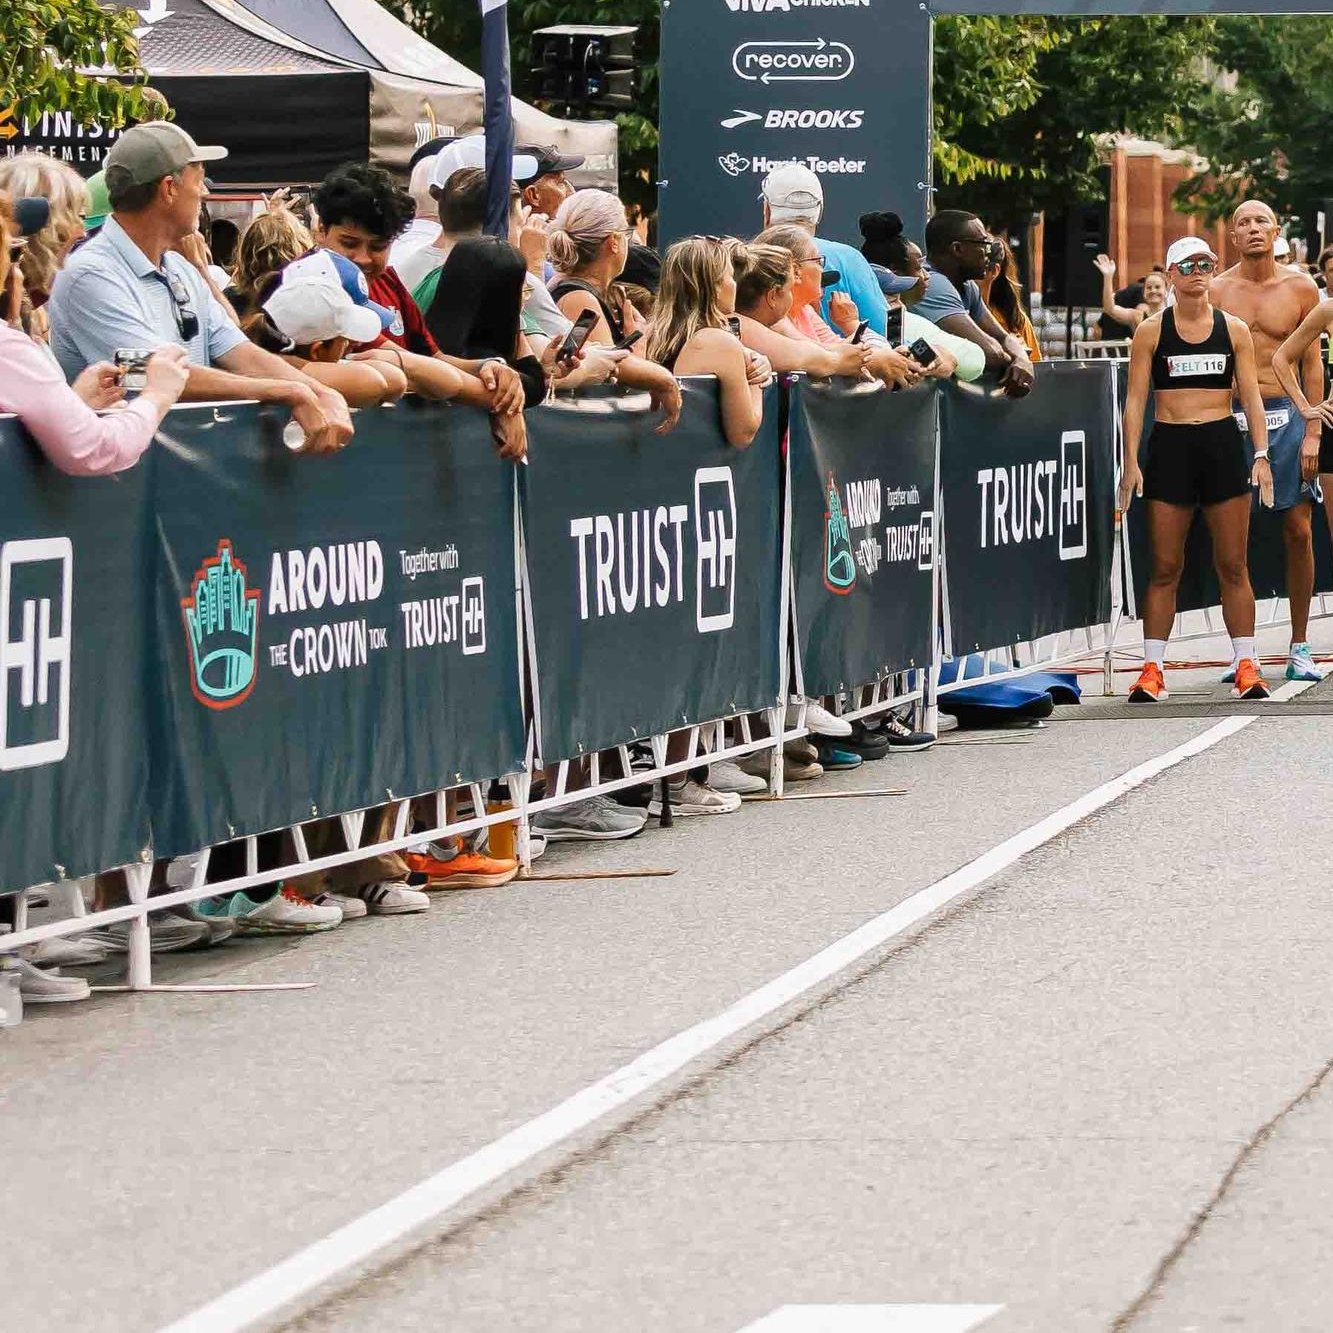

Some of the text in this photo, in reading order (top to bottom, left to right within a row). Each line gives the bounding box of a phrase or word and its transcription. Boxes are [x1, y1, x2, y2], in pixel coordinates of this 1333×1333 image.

[765, 109, 865, 129] BROOKS
[805, 156, 866, 175] Teeter
[1204, 360, 1224, 371] 116
[977, 459, 1058, 550] TRUIST
[399, 544, 459, 582] Together with
[569, 504, 689, 621] TRUIST
[886, 524, 919, 563] TRUIST
[268, 538, 384, 616] AROUND
[401, 594, 459, 651] TRUIST
[269, 618, 388, 678] THE CROWN 10K
